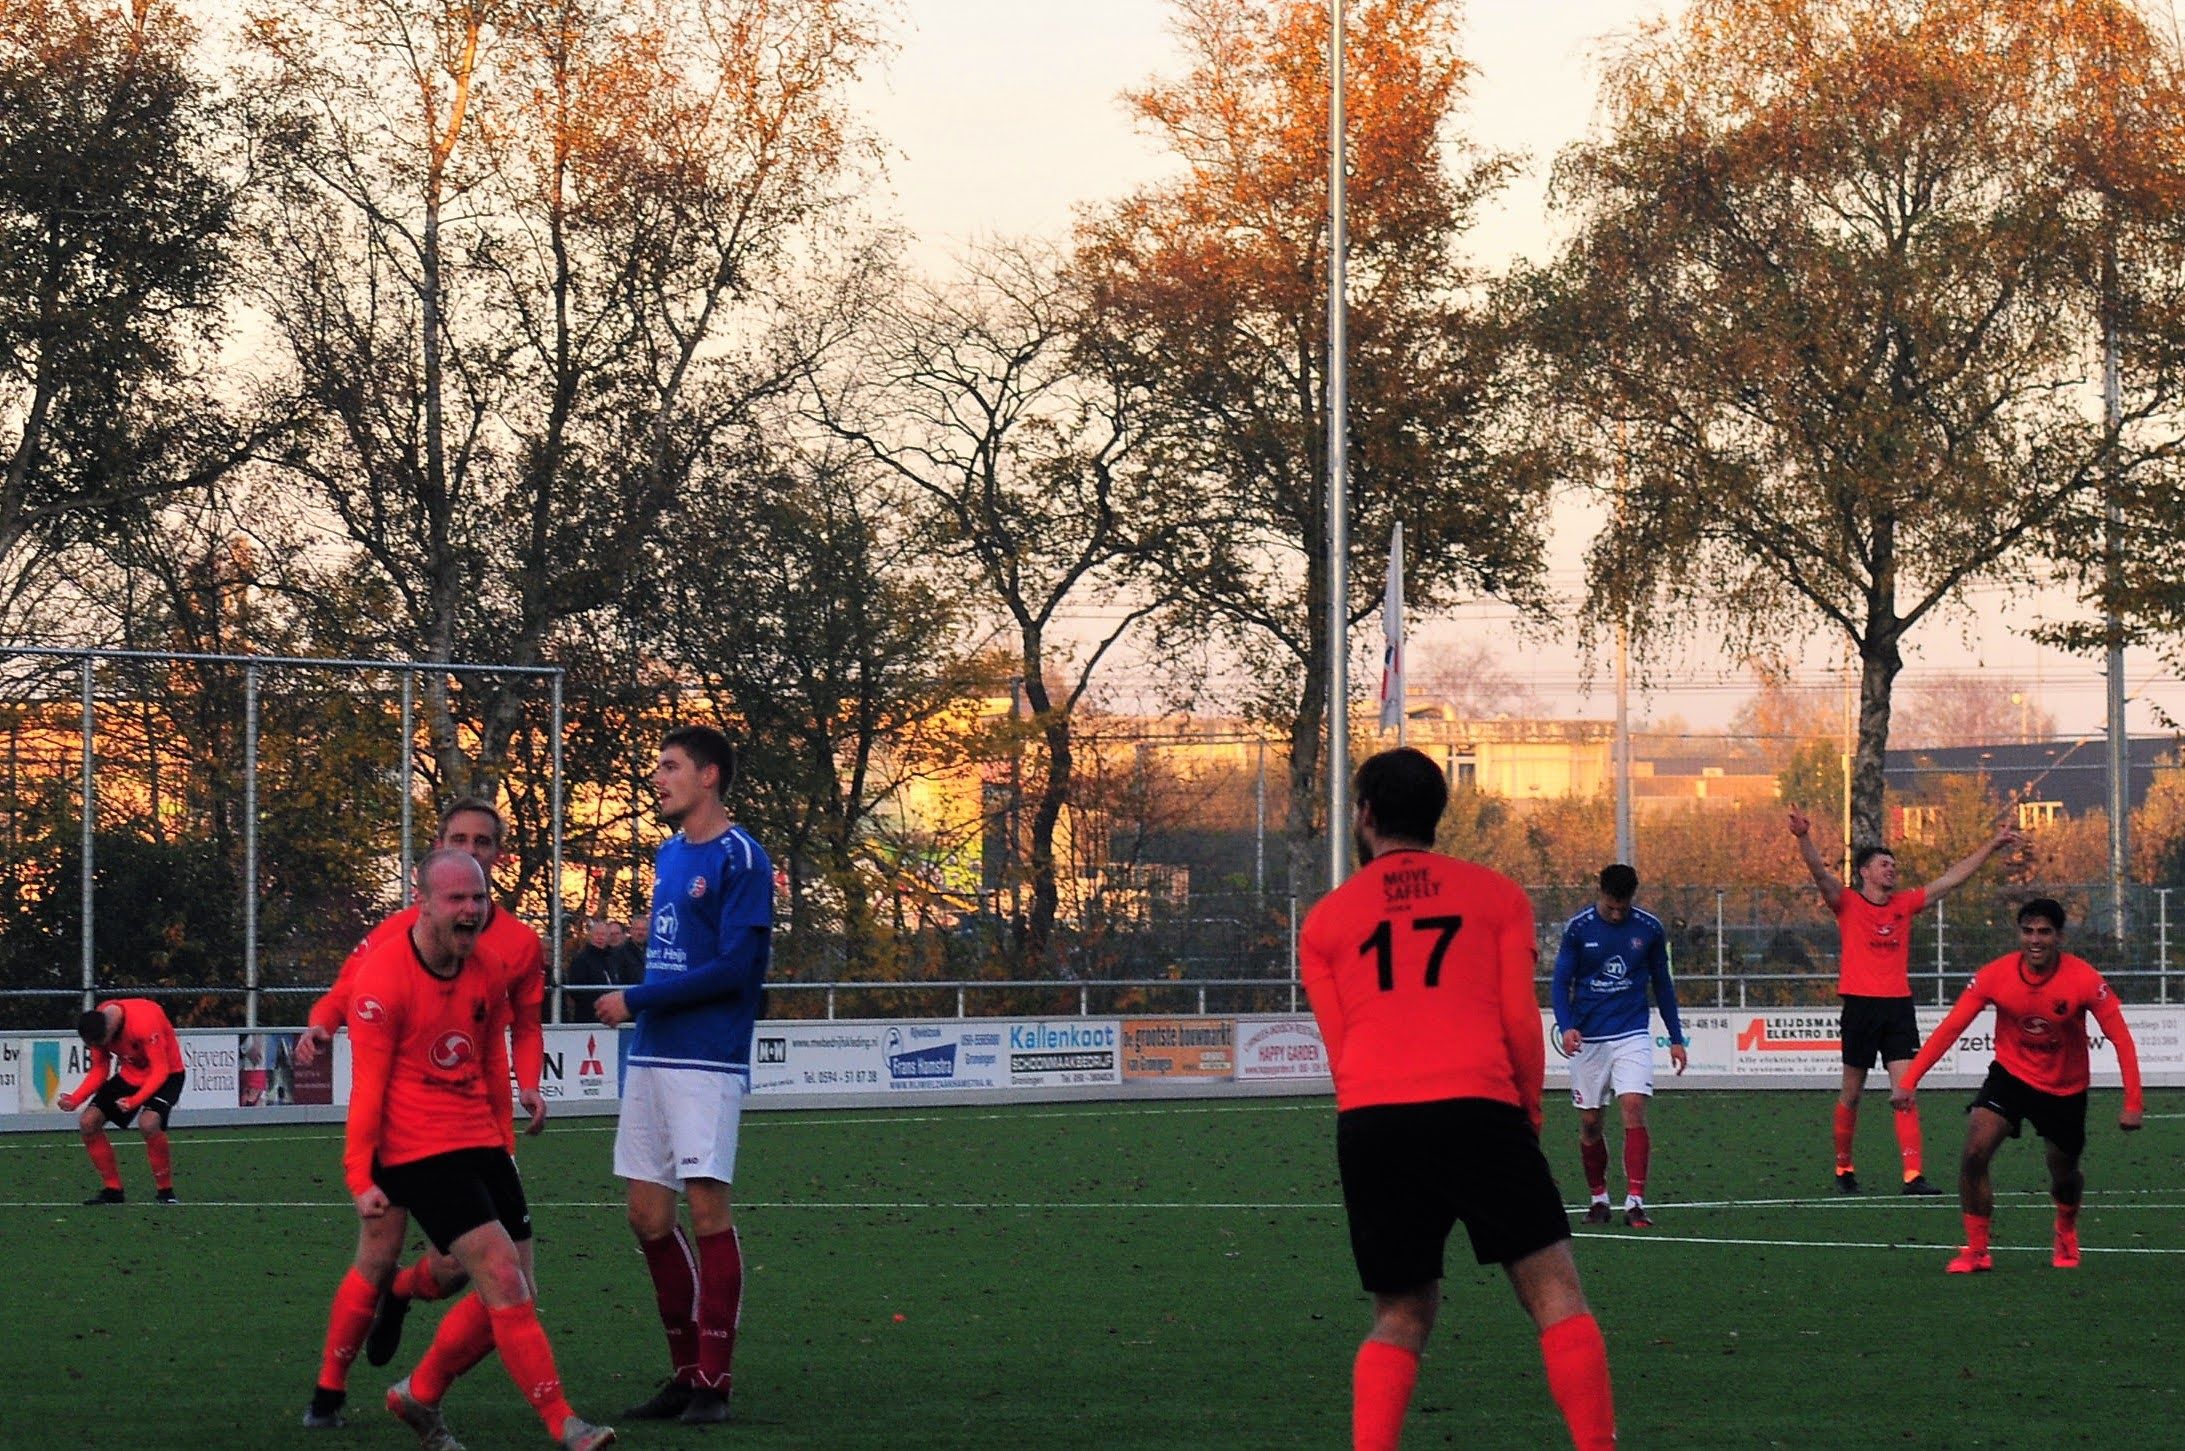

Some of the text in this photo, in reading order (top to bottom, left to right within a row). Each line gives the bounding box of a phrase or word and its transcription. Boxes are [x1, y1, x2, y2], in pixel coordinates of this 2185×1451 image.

[1383, 869, 1431, 885] MOVE
[1384, 880, 1442, 901] SAFELY
[1359, 915, 1463, 992] 17
[1010, 1024, 1114, 1049] Kallenkoot
[1767, 1030, 1821, 1039] ELEKTRO
[1960, 1034, 1996, 1051] zet
[68, 1045, 93, 1073] AB
[185, 1043, 235, 1068] Stevens
